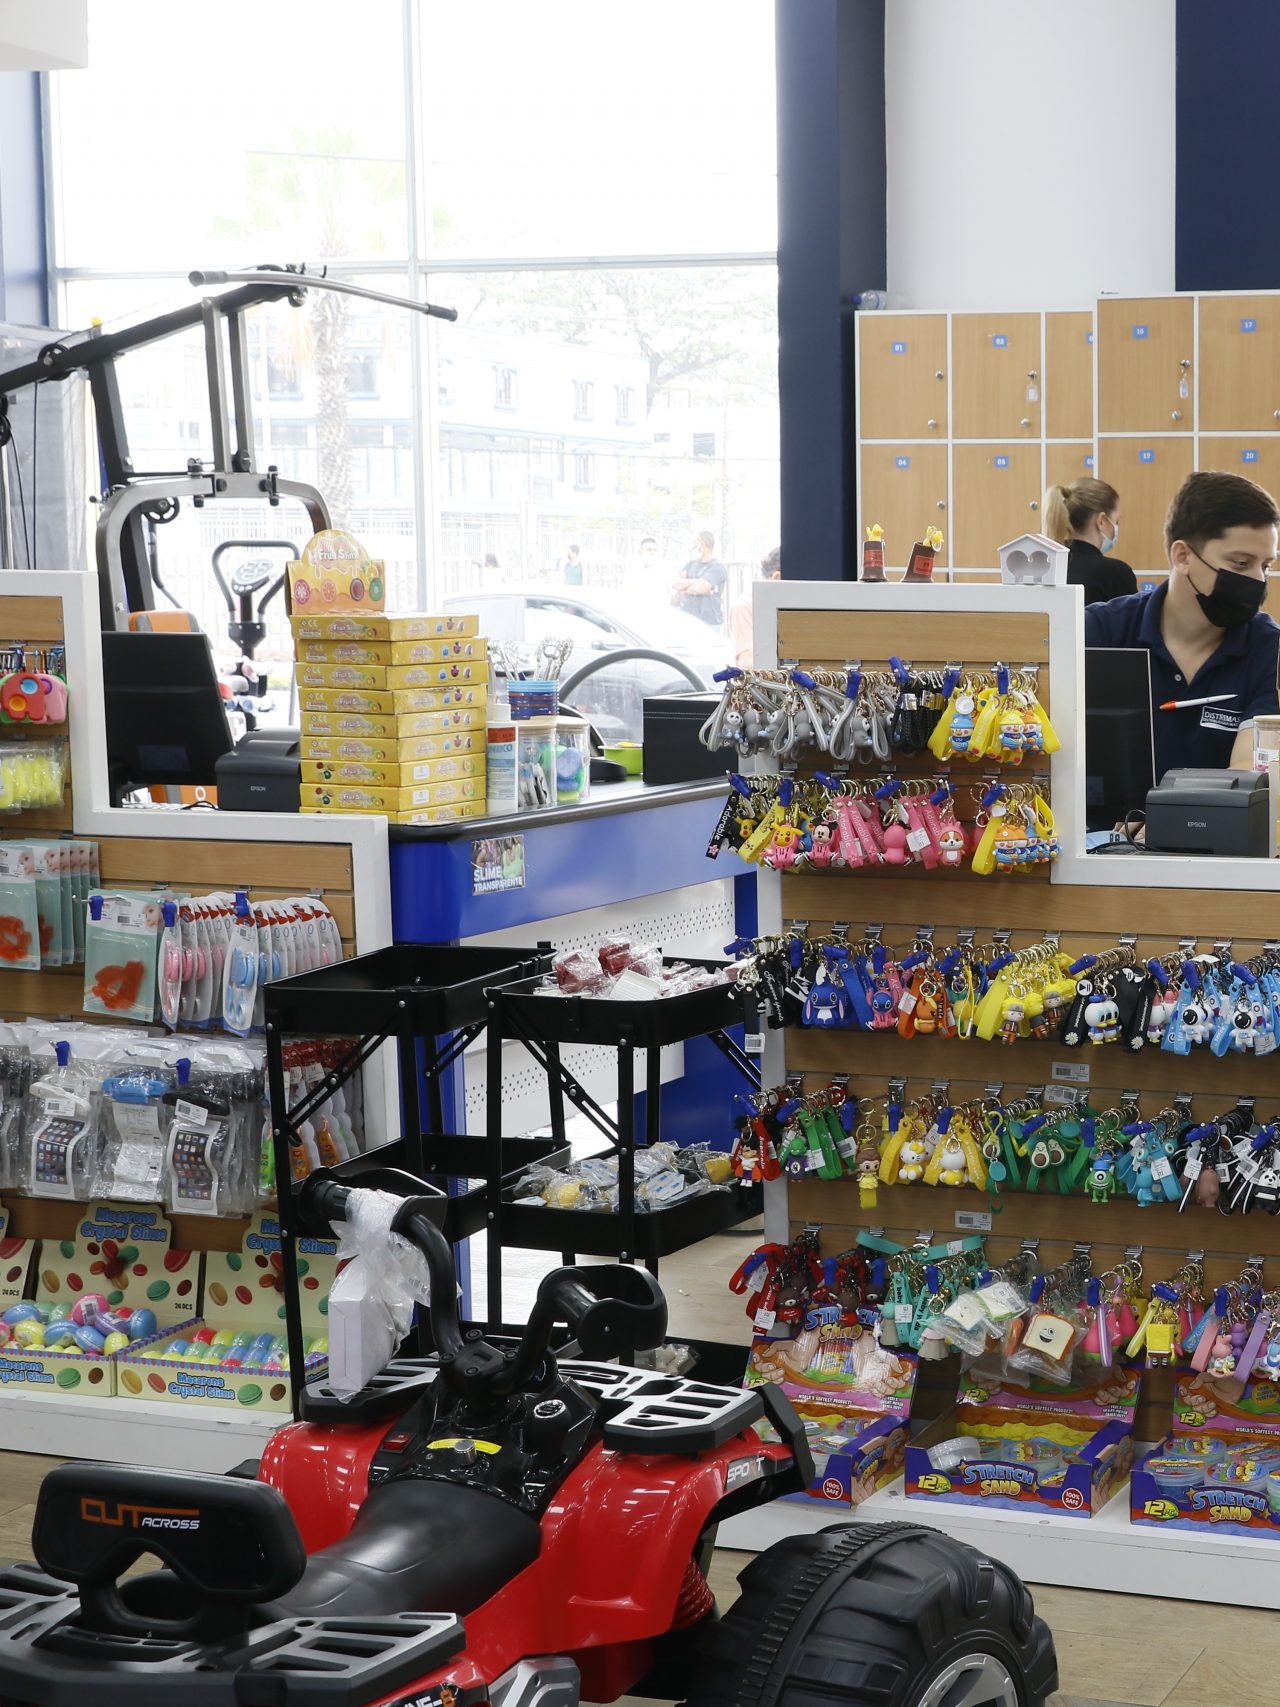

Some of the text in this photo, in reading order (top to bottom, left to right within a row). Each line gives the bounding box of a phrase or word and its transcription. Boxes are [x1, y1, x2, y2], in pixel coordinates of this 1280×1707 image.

[714, 804, 733, 841] Adorable
[473, 865, 502, 882] SLIME
[473, 875, 523, 893] TRANSPARENTE
[95, 1207, 157, 1225] Macarons
[80, 1221, 167, 1242] Crystal Slime
[299, 1237, 337, 1255] Slime
[805, 1305, 878, 1331] STRCH
[27, 1370, 55, 1384] Slime
[177, 1372, 225, 1387] Macarons
[168, 1383, 236, 1401] Crystal Slime
[1254, 1428, 1274, 1436] SOFTEST
[918, 1474, 936, 1490] 12
[963, 1463, 1035, 1485] STRETCH
[825, 1482, 841, 1490] 100%
[825, 1488, 840, 1497] SAFE
[980, 1480, 1021, 1497] SAND
[1065, 1491, 1081, 1499] 100%
[1065, 1497, 1079, 1506] SAFE
[1192, 1490, 1266, 1510] STRETCH
[1144, 1501, 1165, 1516] 12
[1209, 1506, 1252, 1523] SAND
[141, 1517, 200, 1530] ACROSS
